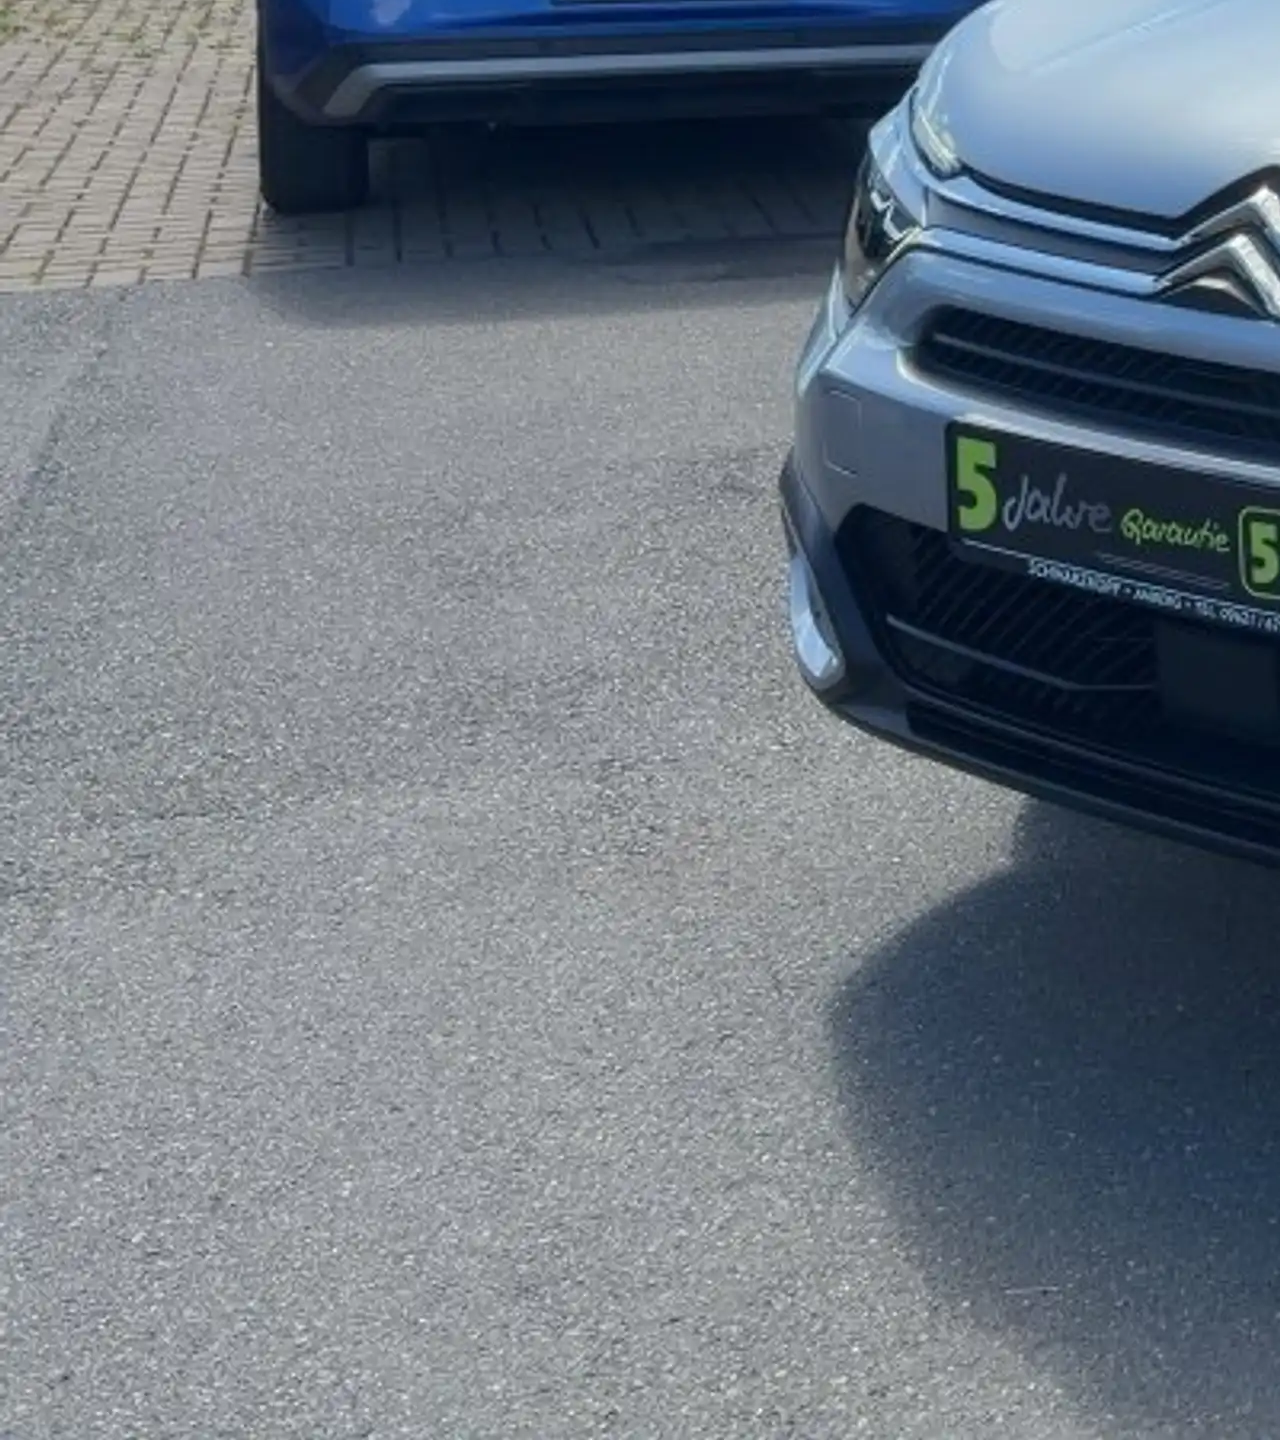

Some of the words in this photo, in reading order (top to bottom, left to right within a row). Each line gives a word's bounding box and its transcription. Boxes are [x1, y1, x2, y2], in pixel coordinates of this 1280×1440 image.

[957, 436, 997, 531] 5
[1002, 472, 1112, 531] Jahre
[1121, 508, 1230, 553] Garantie
[1251, 521, 1279, 584] 5
